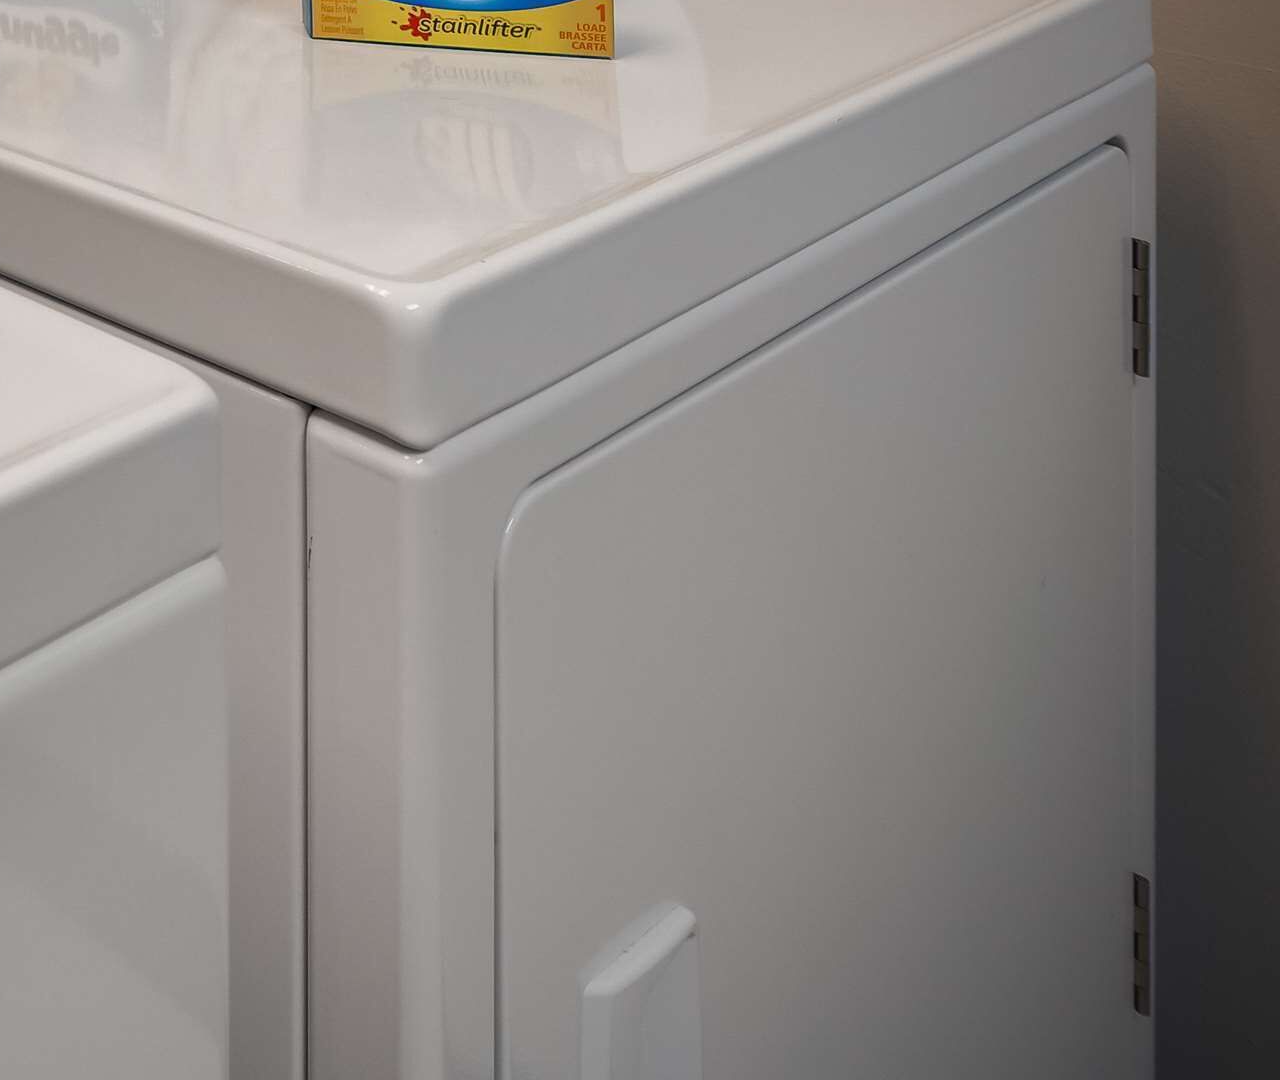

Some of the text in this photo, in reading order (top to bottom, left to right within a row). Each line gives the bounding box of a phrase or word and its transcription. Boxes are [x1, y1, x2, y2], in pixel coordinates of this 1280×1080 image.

[596, 4, 606, 22] 1
[419, 16, 534, 39] stainlifter
[576, 22, 607, 33] LOAD
[559, 31, 607, 43] BRASSEE
[571, 41, 607, 52] CARTA
